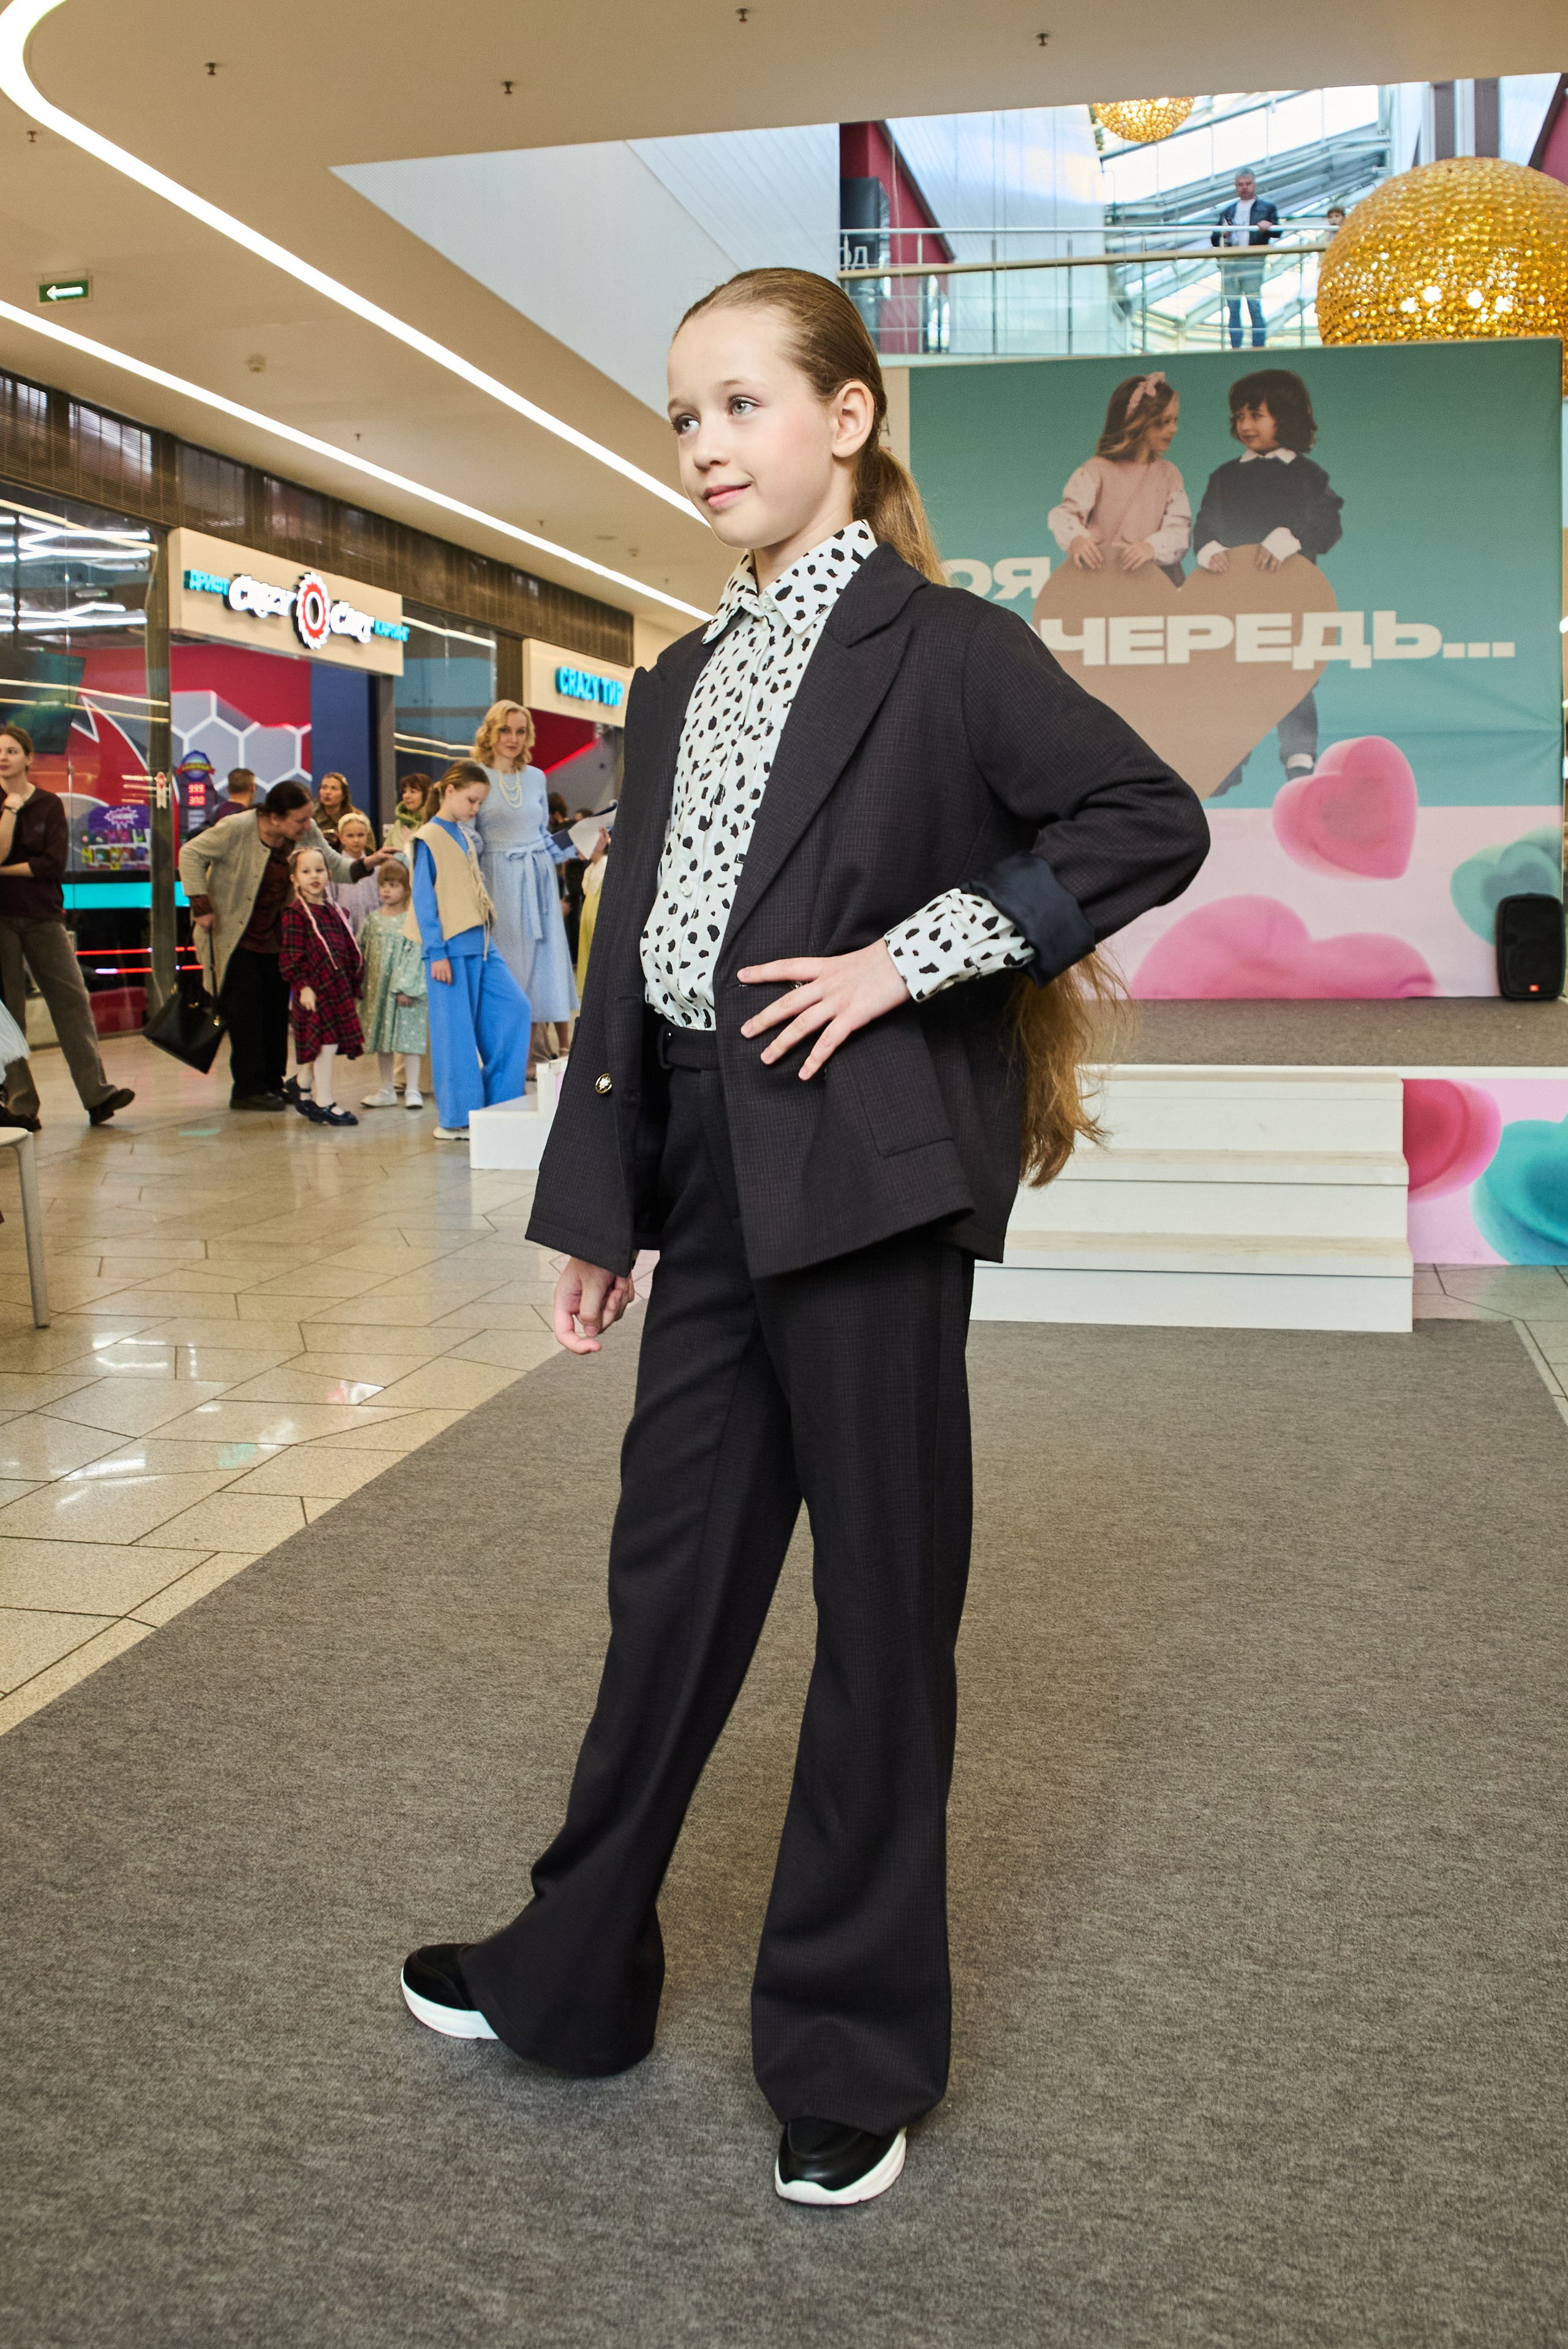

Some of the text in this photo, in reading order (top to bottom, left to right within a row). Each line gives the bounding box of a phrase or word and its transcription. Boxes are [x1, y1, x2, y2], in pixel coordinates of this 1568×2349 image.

[940, 556, 1050, 600] ОЯ
[1027, 610, 1516, 670] ЧЕРЕДЬ...
[559, 665, 625, 707] CRAZY ТИР
[188, 783, 206, 795] 999
